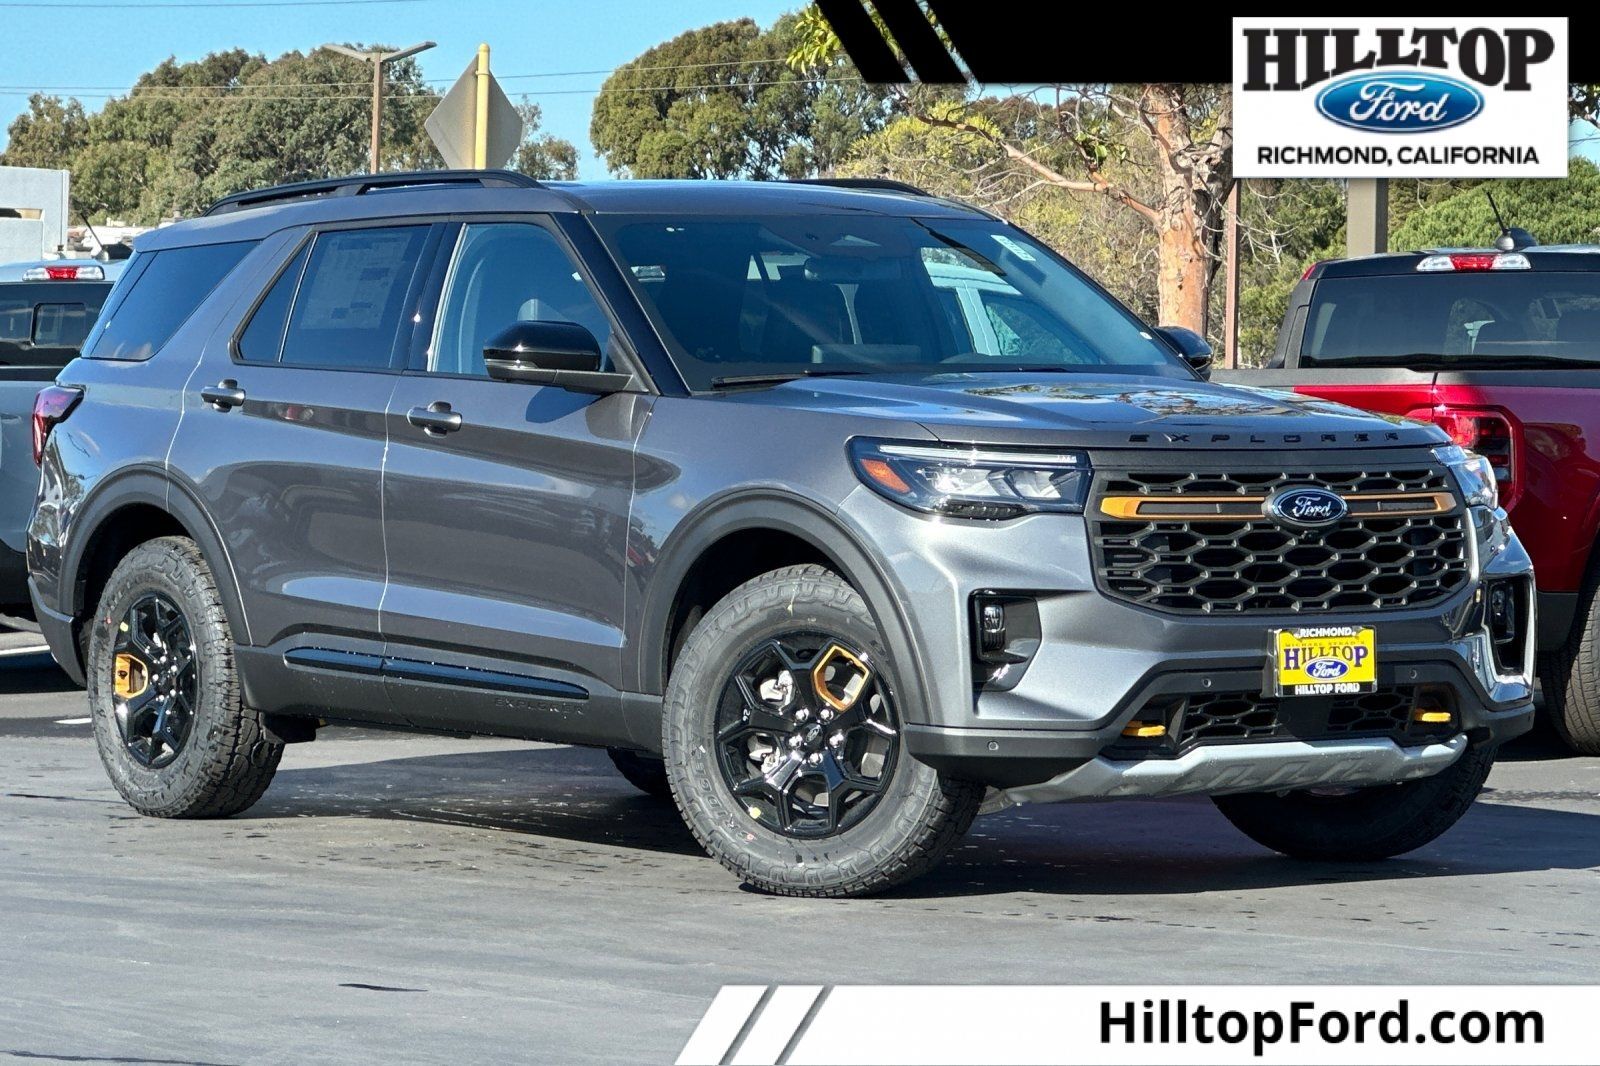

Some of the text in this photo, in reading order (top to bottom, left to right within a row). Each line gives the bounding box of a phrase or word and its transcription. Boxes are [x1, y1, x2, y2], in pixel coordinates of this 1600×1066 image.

[1128, 431, 1399, 443] EXPLORER
[1292, 495, 1332, 517] Ford
[1300, 627, 1352, 638] RICHMOND
[1284, 645, 1368, 670] HILLTOP
[1312, 661, 1341, 677] Ford
[1295, 682, 1360, 695] HILLTOP FORD
